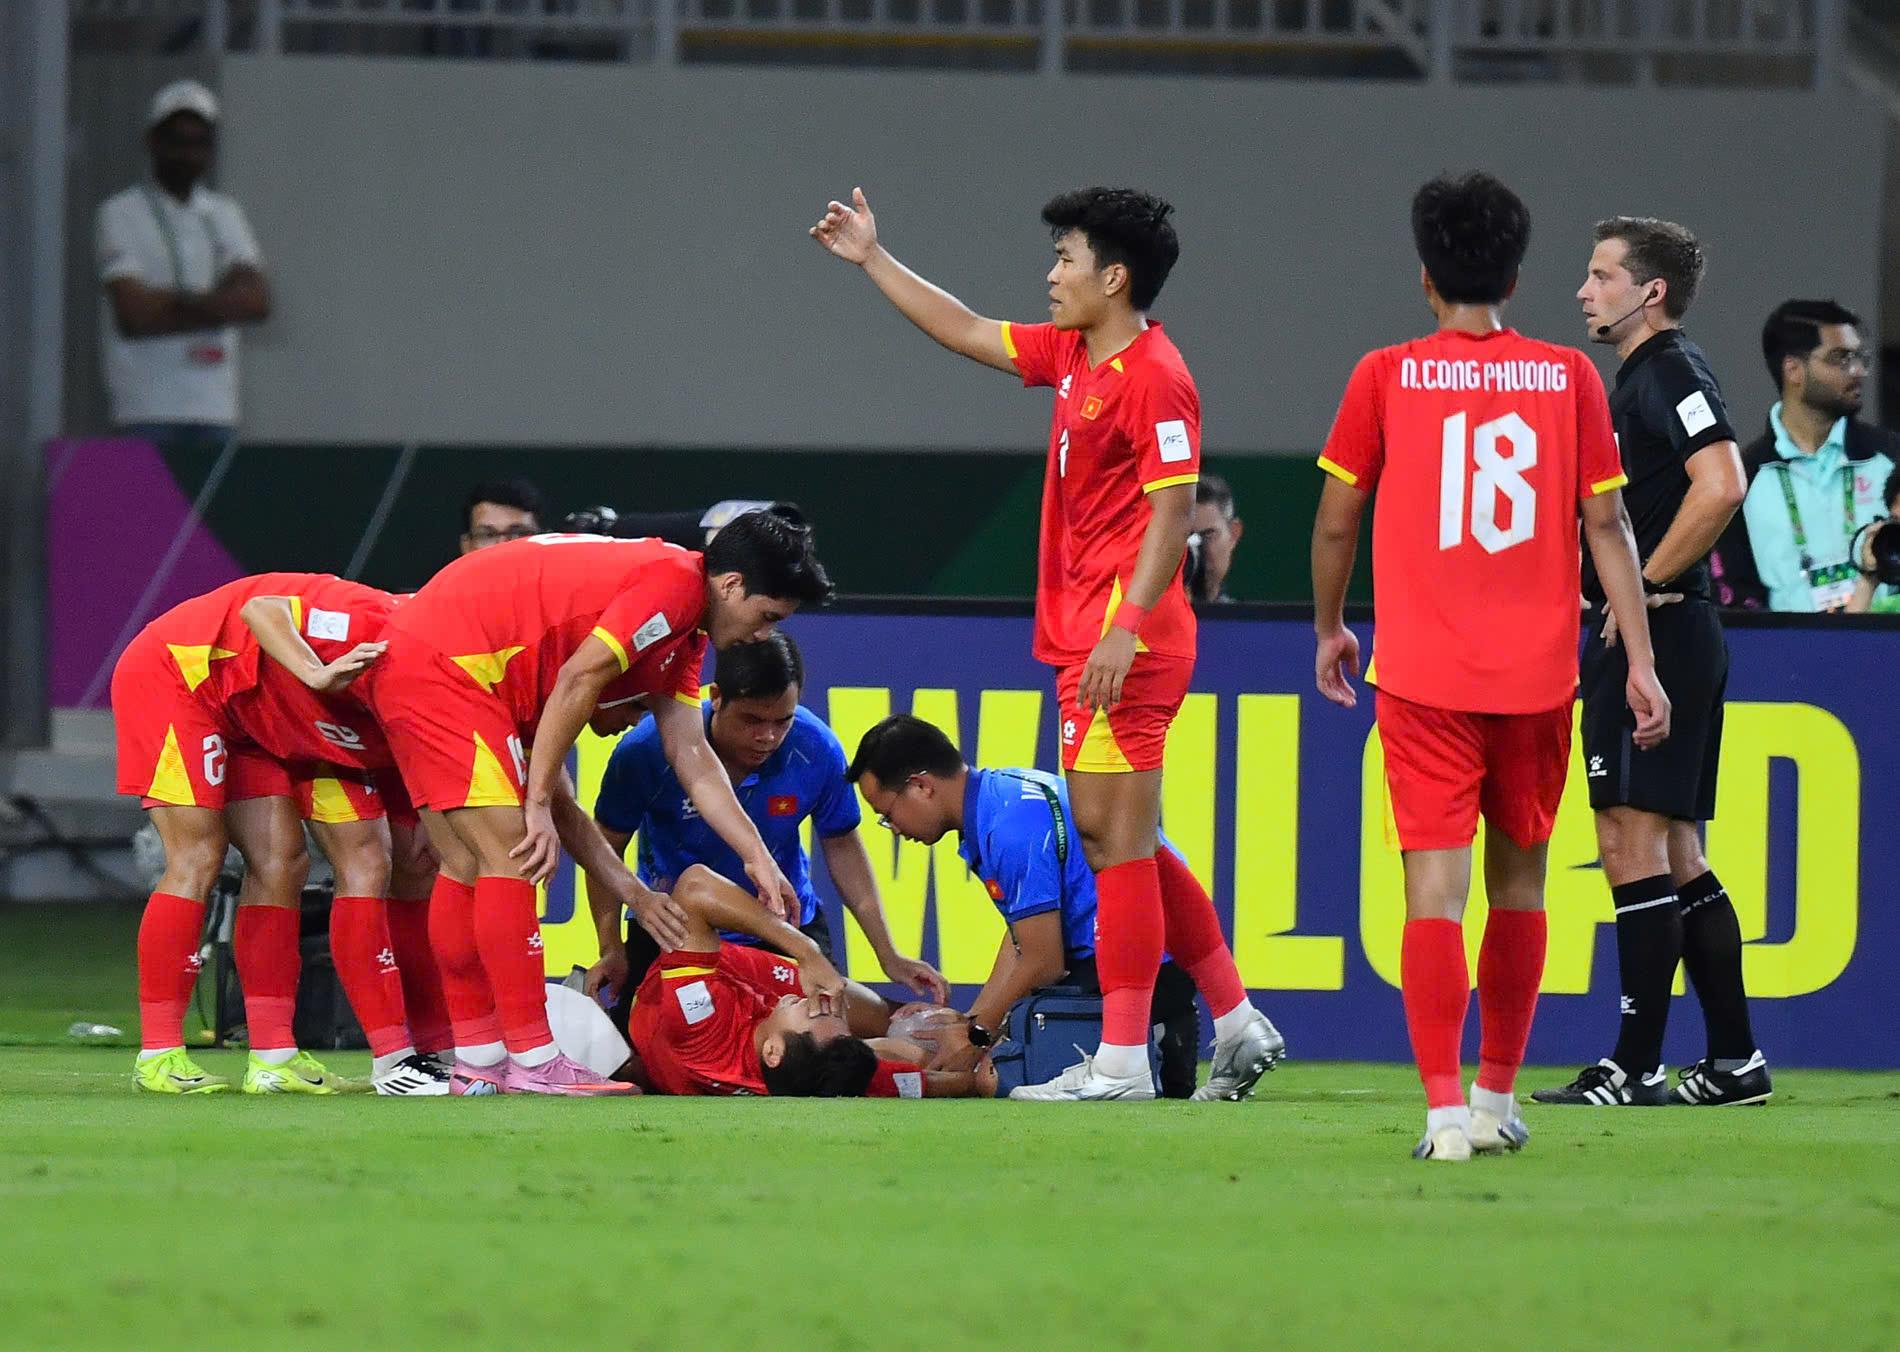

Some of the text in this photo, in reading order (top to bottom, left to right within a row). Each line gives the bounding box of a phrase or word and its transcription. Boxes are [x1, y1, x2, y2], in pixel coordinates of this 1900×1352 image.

[1400, 357, 1567, 392] N.CONG PHUONG
[1439, 410, 1538, 555] 18
[203, 733, 228, 787] 2
